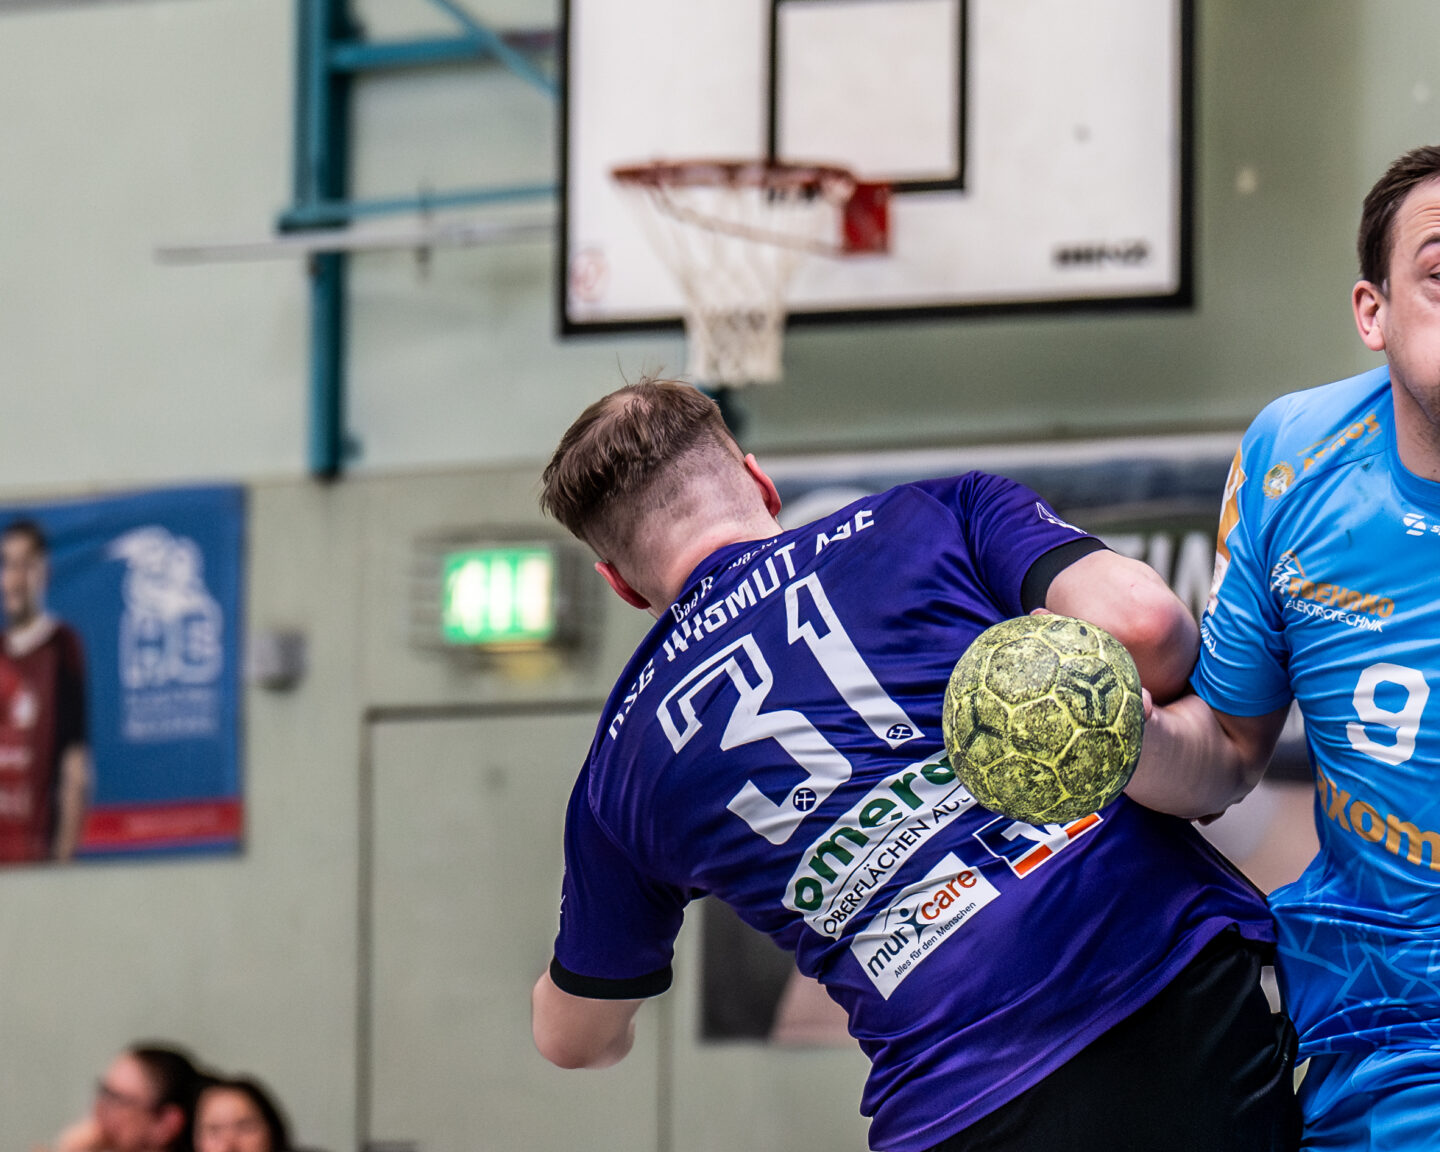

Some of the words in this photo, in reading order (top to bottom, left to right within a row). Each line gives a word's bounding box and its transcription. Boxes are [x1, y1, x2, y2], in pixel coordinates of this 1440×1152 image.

[671, 591, 699, 623] Bad
[656, 571, 926, 845] 31
[1345, 662, 1431, 766] 9
[823, 819, 931, 934] OBERFLÄCHEN
[867, 927, 910, 977] mur
[921, 870, 977, 920] care
[894, 960, 911, 978] Alles
[936, 901, 977, 936] Menschen
